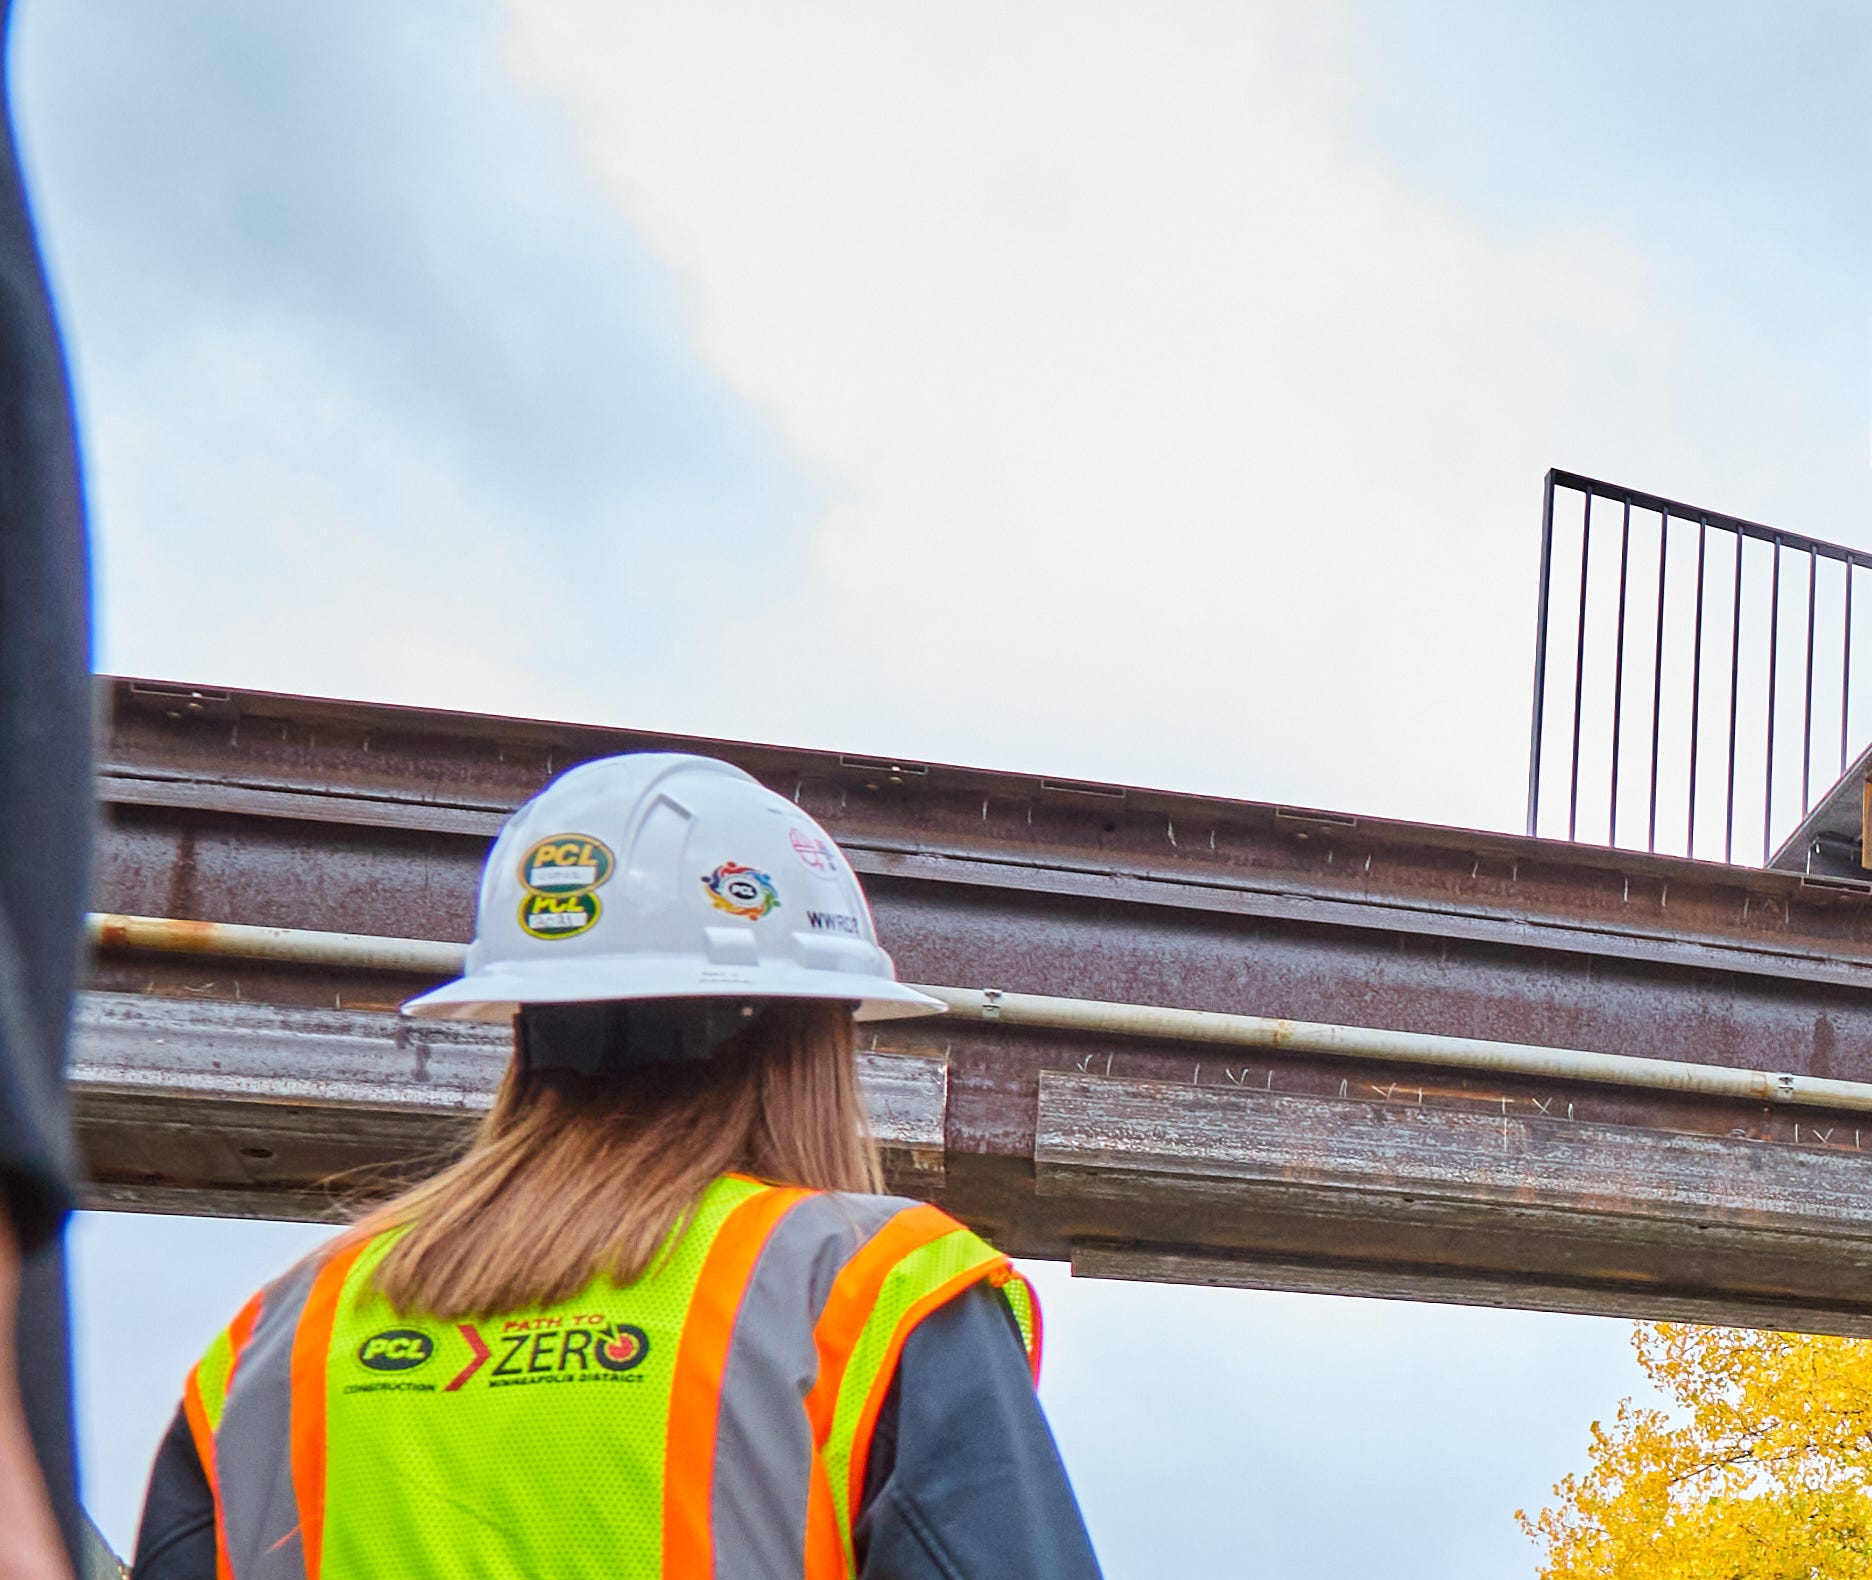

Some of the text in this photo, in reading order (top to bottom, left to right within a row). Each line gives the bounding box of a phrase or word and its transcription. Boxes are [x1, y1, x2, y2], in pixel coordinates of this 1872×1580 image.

[533, 843, 598, 868] PCL
[503, 1314, 604, 1332] PATH TO
[362, 1337, 426, 1361] PCL
[344, 1382, 436, 1395] CONSTRUCTION
[489, 1373, 645, 1387] MINNEAPOLIS DISTRICT
